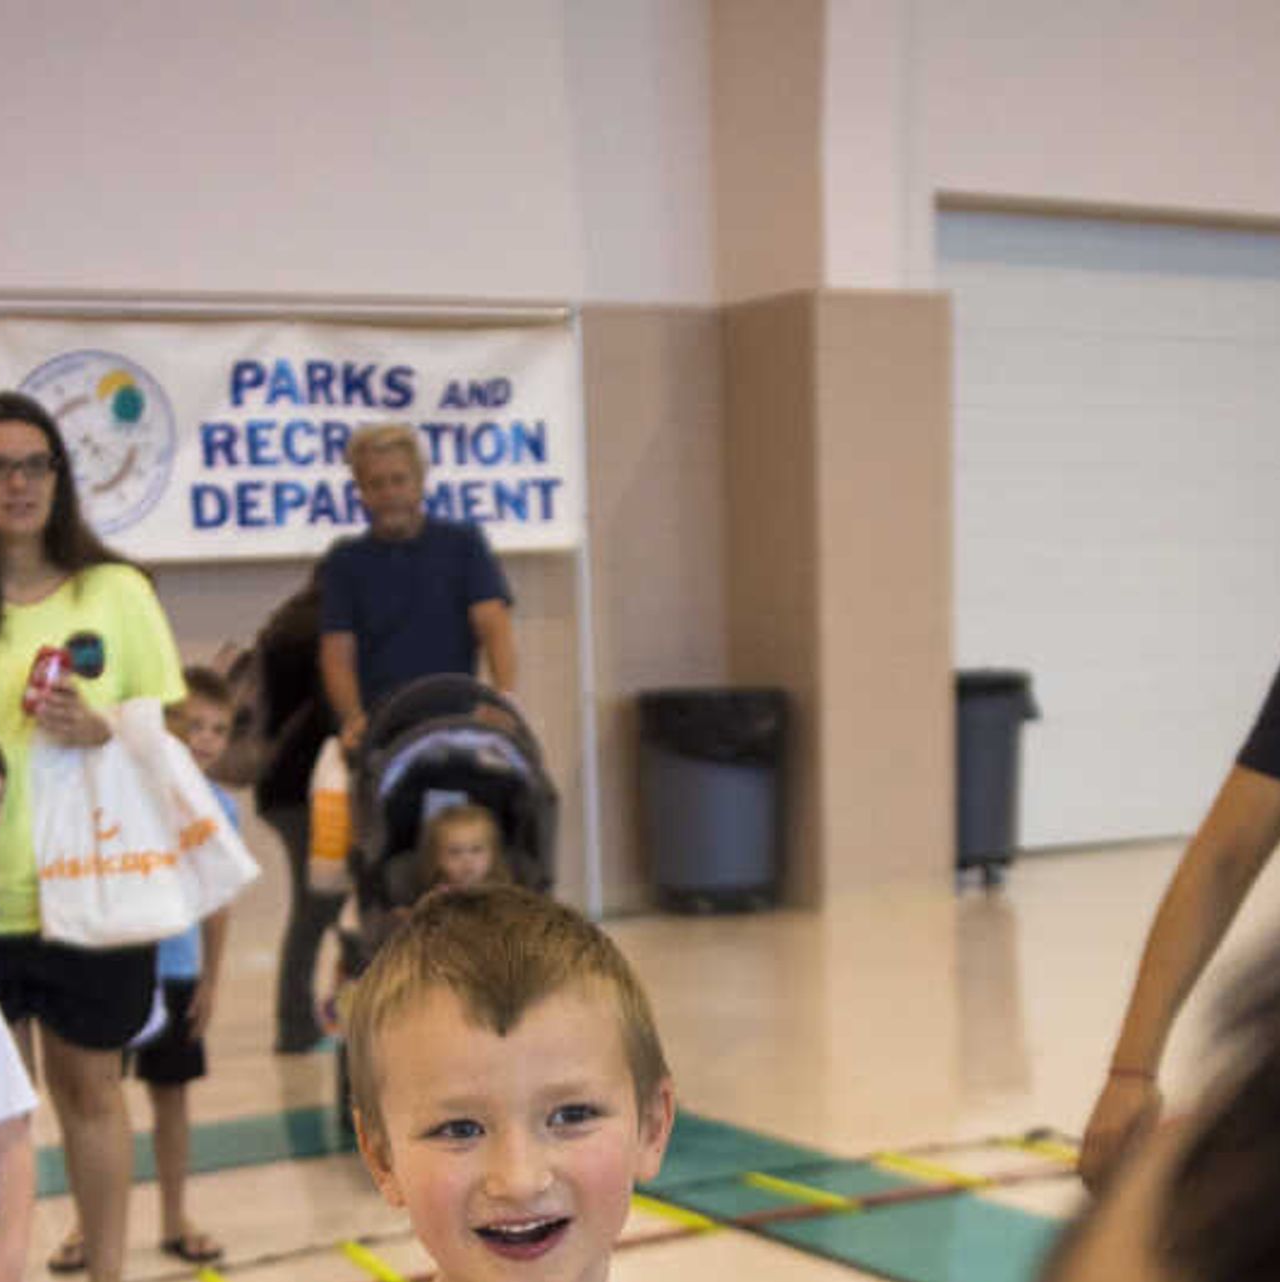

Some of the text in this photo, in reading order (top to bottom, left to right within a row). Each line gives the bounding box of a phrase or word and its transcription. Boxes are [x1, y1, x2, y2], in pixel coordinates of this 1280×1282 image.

[230, 359, 513, 410] PARKS AND
[200, 420, 547, 469] RECRTION
[190, 477, 562, 530] DEPARMENT
